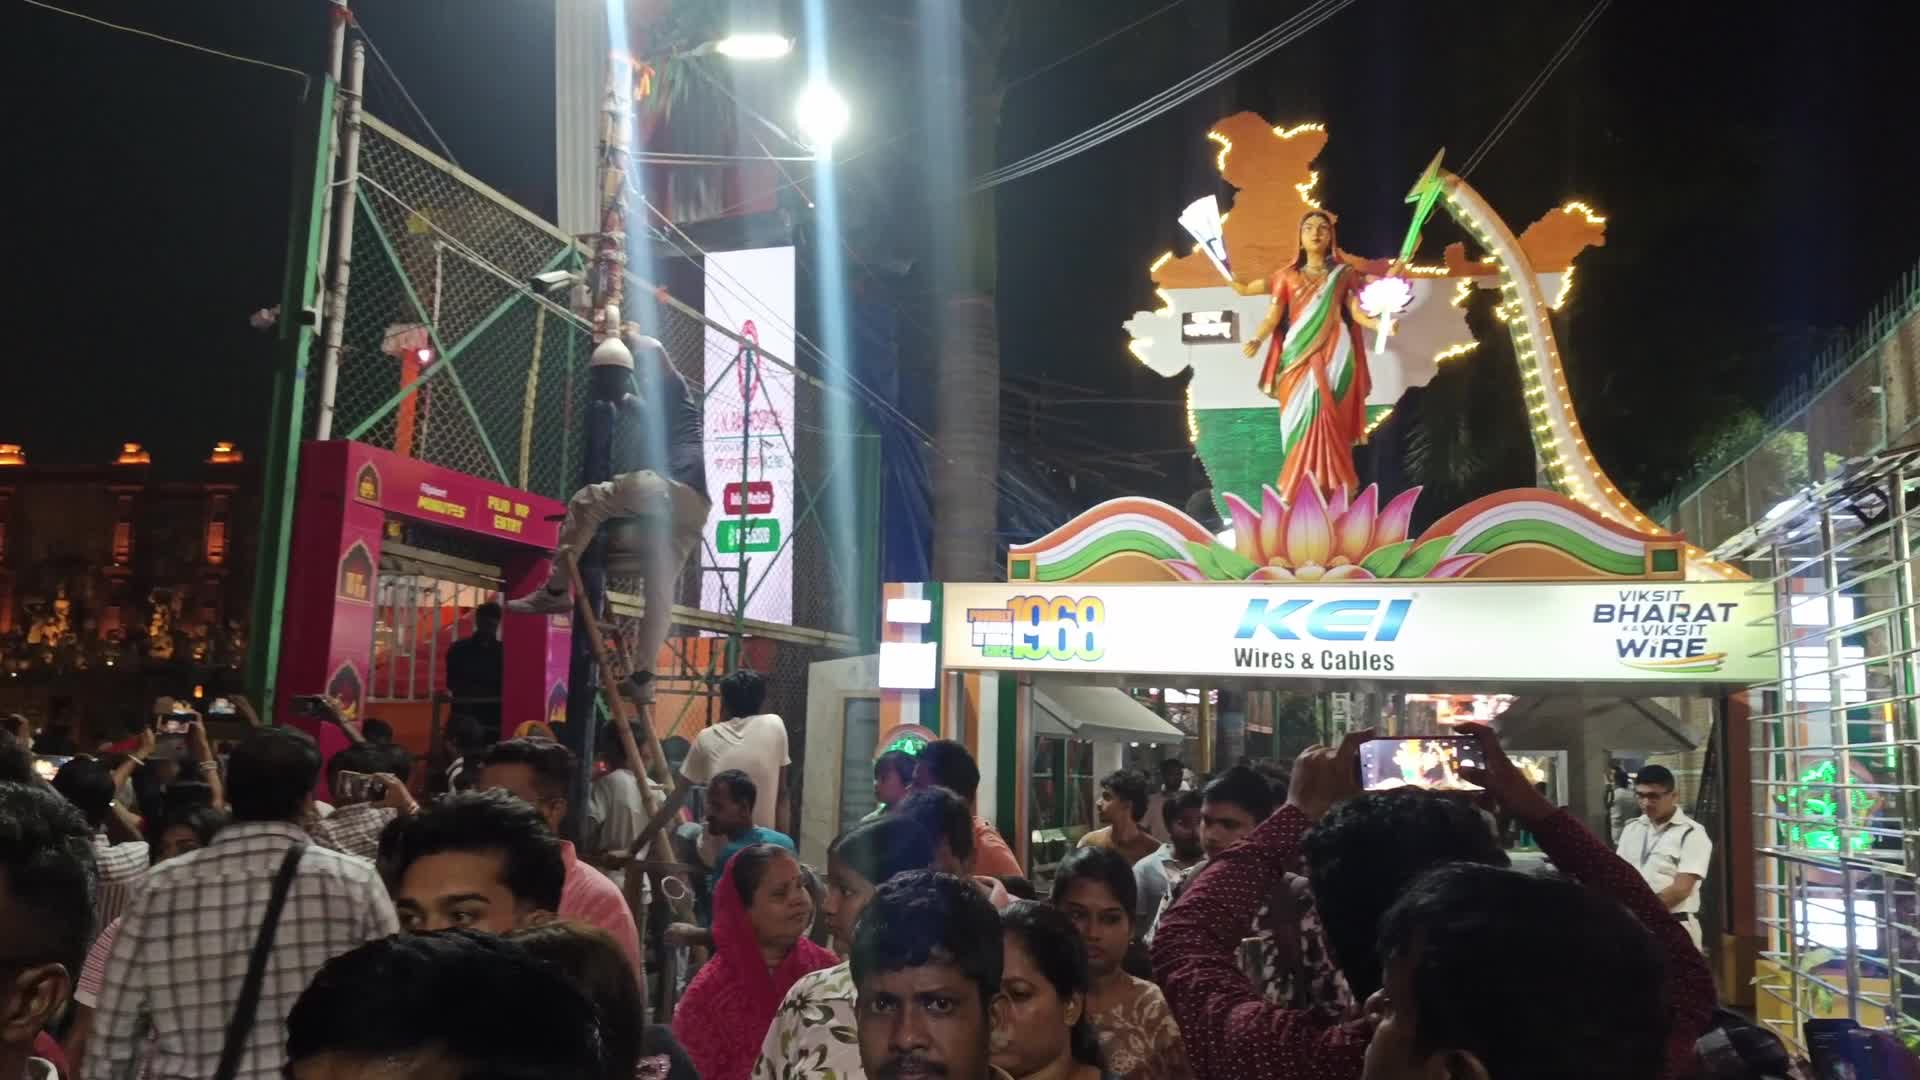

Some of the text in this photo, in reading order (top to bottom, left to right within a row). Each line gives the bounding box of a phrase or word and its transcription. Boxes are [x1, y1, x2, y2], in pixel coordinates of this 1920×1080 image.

[1619, 590, 1685, 602] VIKSIT
[1233, 598, 1412, 641] KEI
[1593, 602, 1738, 623] BHARAT
[1007, 595, 1105, 662] 1968
[1641, 624, 1707, 636] VIKSIT
[1234, 647, 1395, 671] Wires & Cables
